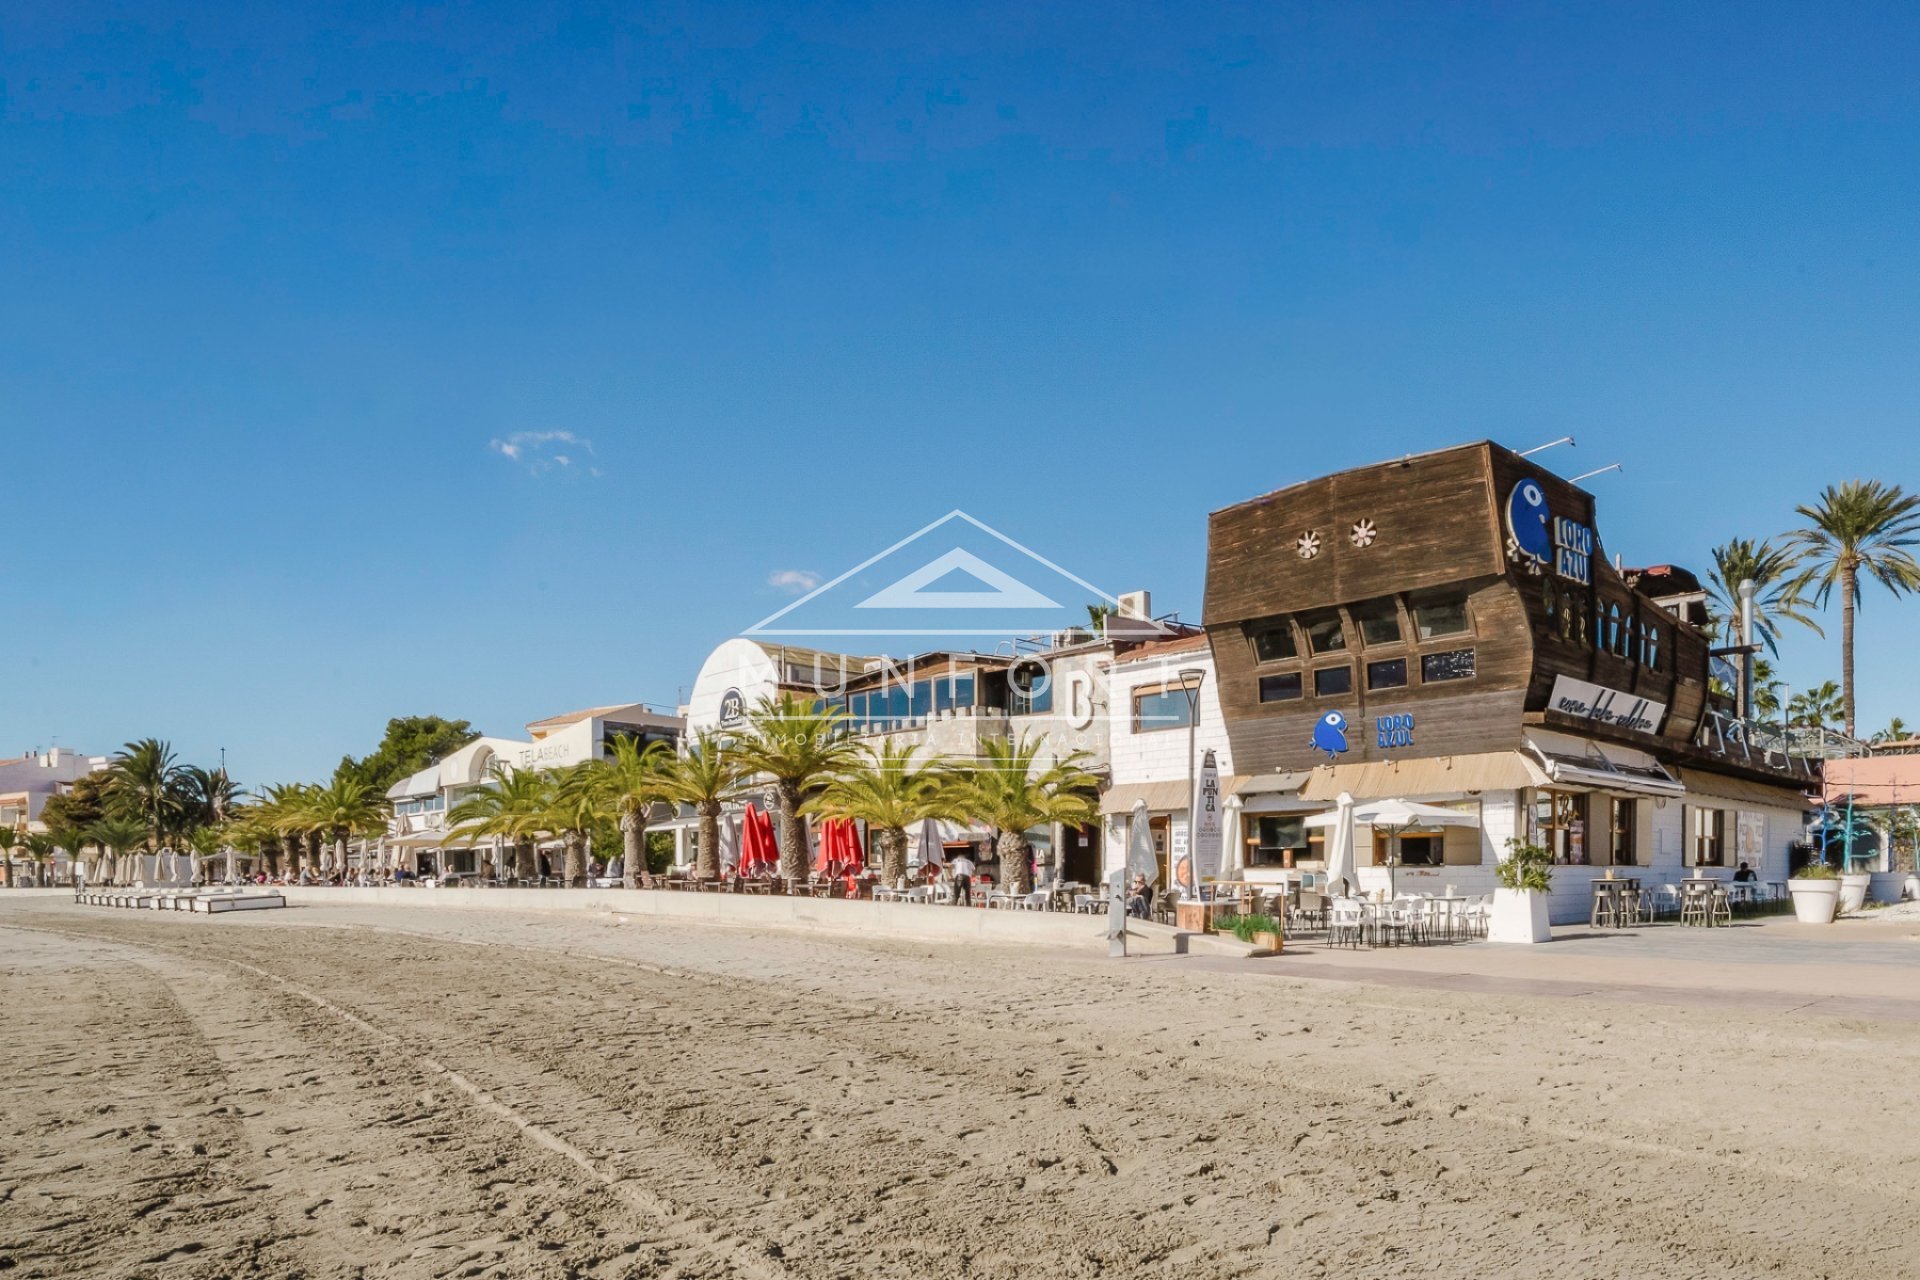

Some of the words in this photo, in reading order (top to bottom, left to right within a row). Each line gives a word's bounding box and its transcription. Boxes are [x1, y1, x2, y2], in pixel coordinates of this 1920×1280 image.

[1554, 516, 1593, 556] LORO
[1556, 547, 1590, 586] AZUL
[1376, 713, 1414, 732] LORO
[1378, 729, 1414, 749] AZUL
